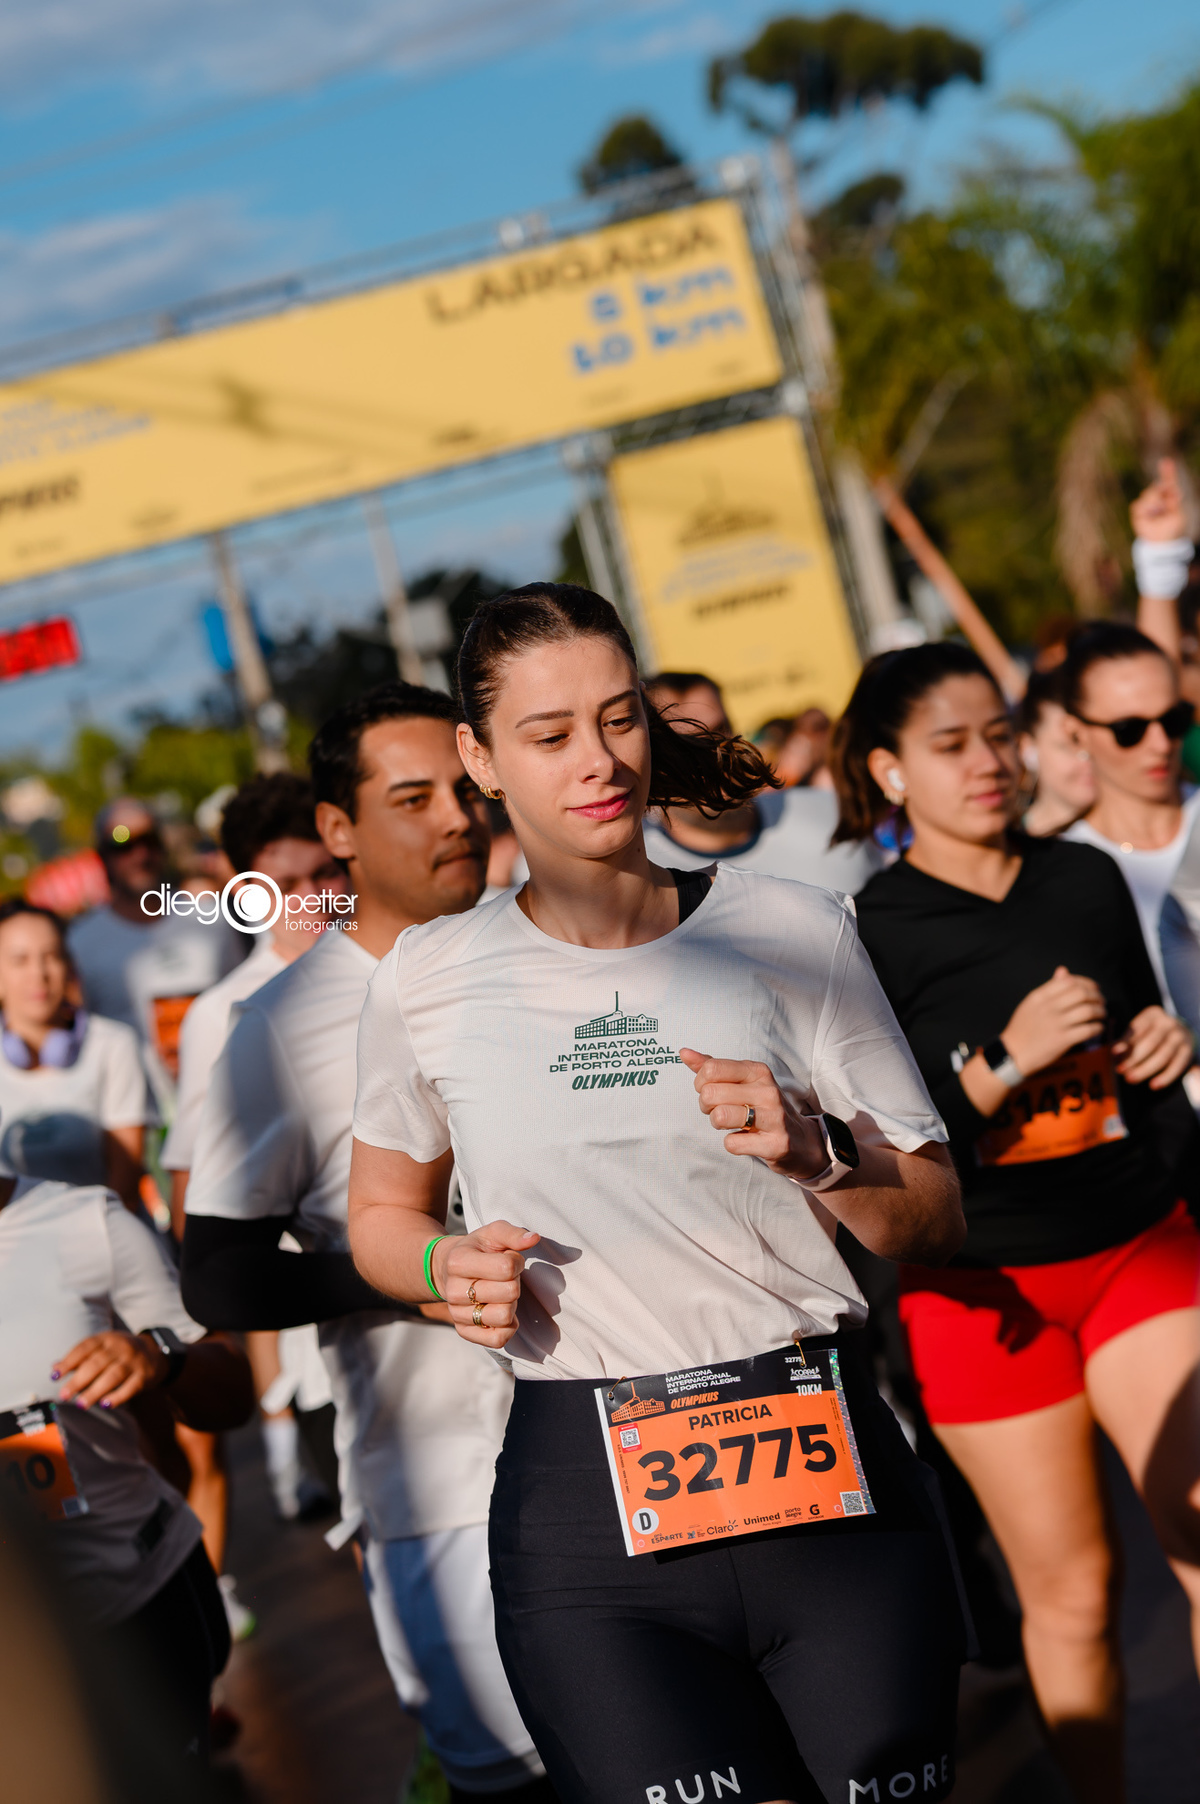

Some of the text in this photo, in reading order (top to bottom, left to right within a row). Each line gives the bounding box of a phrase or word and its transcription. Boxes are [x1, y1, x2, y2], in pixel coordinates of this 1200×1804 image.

[424, 219, 719, 324] LARGADA
[558, 1046, 675, 1063] INTERNACIONAL
[574, 1038, 658, 1052] MARATONA
[549, 1055, 683, 1073] DE PORTO ALEGRE
[571, 1069, 659, 1091] OLYMPIKUS
[665, 1368, 713, 1383] MARATONA
[666, 1372, 731, 1389] INTERNACIONAL
[667, 1375, 741, 1395] DE PORTO ALEGRE
[796, 1383, 822, 1396] 10KM
[670, 1391, 719, 1409] OLYMPIKUS
[688, 1404, 773, 1430] PATRICIA
[637, 1423, 837, 1502] 32775
[639, 1511, 652, 1531] D
[706, 1524, 734, 1535] Claro
[743, 1512, 781, 1526] Unimed
[645, 1754, 948, 1804] RUN MORE
